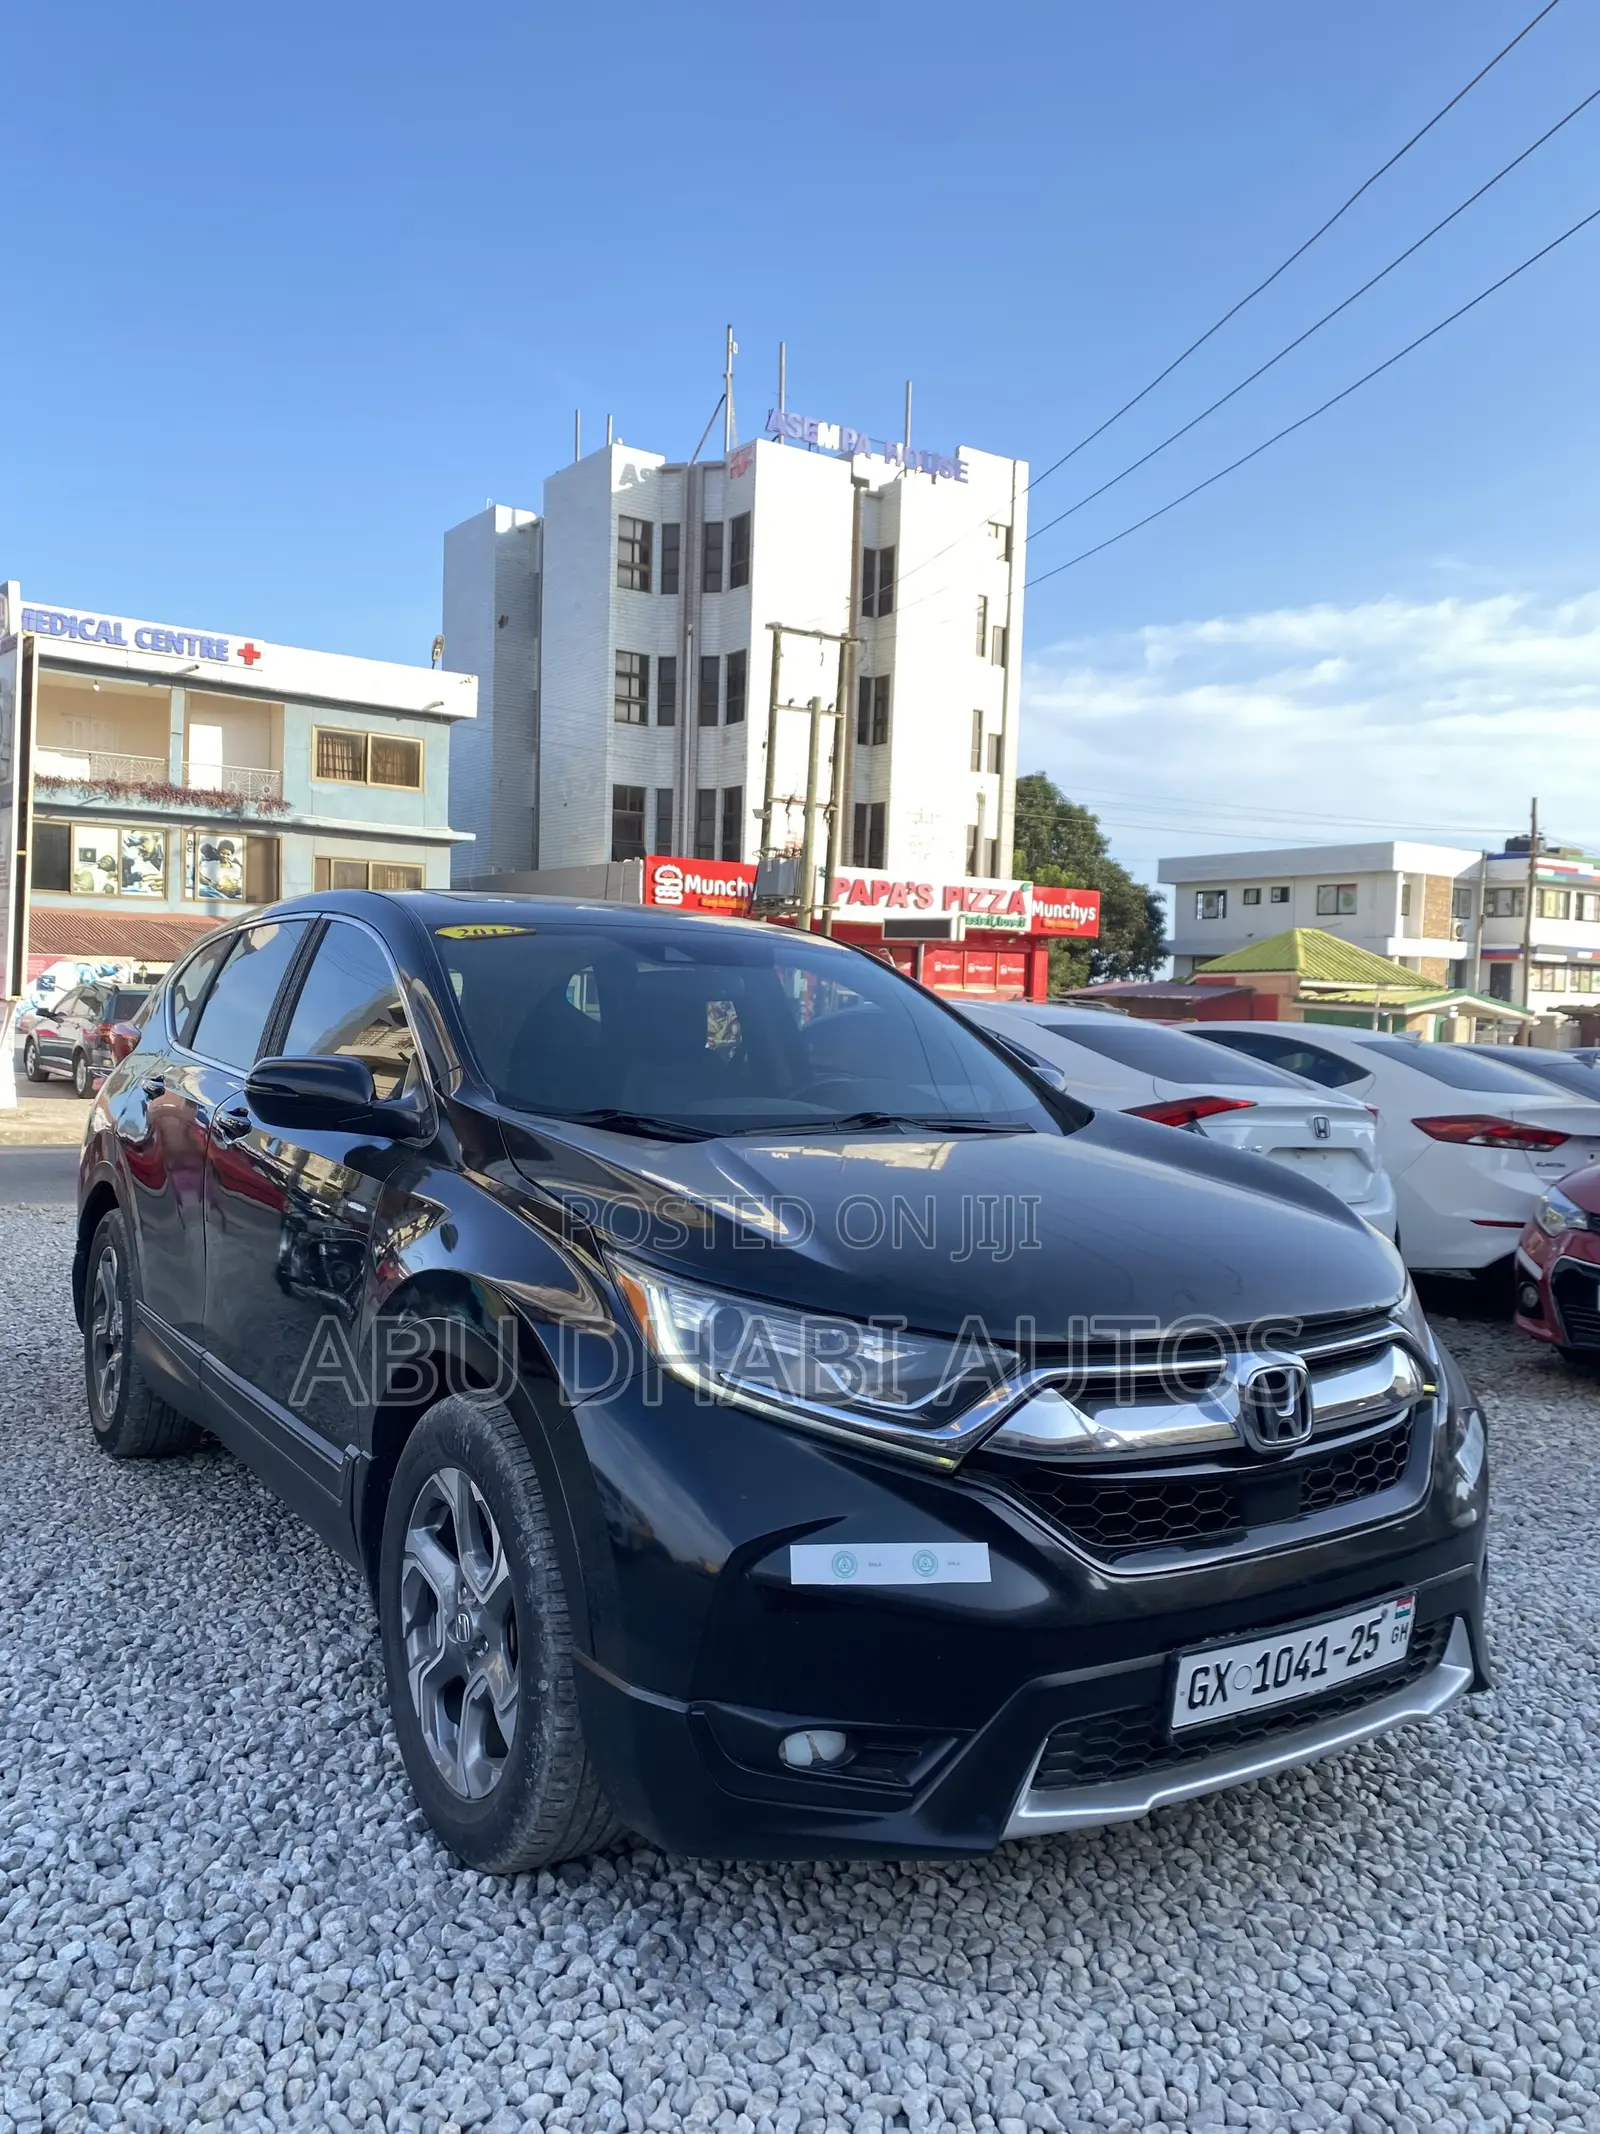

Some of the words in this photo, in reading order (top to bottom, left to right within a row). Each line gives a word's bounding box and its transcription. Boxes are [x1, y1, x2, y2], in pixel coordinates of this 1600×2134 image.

[765, 408, 872, 459] ASEMPA
[884, 439, 969, 483] HOUSE
[21, 608, 128, 645] MEDICAL
[134, 627, 229, 661] CENTRE
[833, 877, 934, 909] PAPA'S
[942, 885, 1026, 915] PIZZA
[1032, 900, 1096, 925] Munchys
[1391, 1621, 1410, 1646] GH
[1187, 1659, 1233, 1709] GX
[1251, 1616, 1385, 1694] 1041-25
